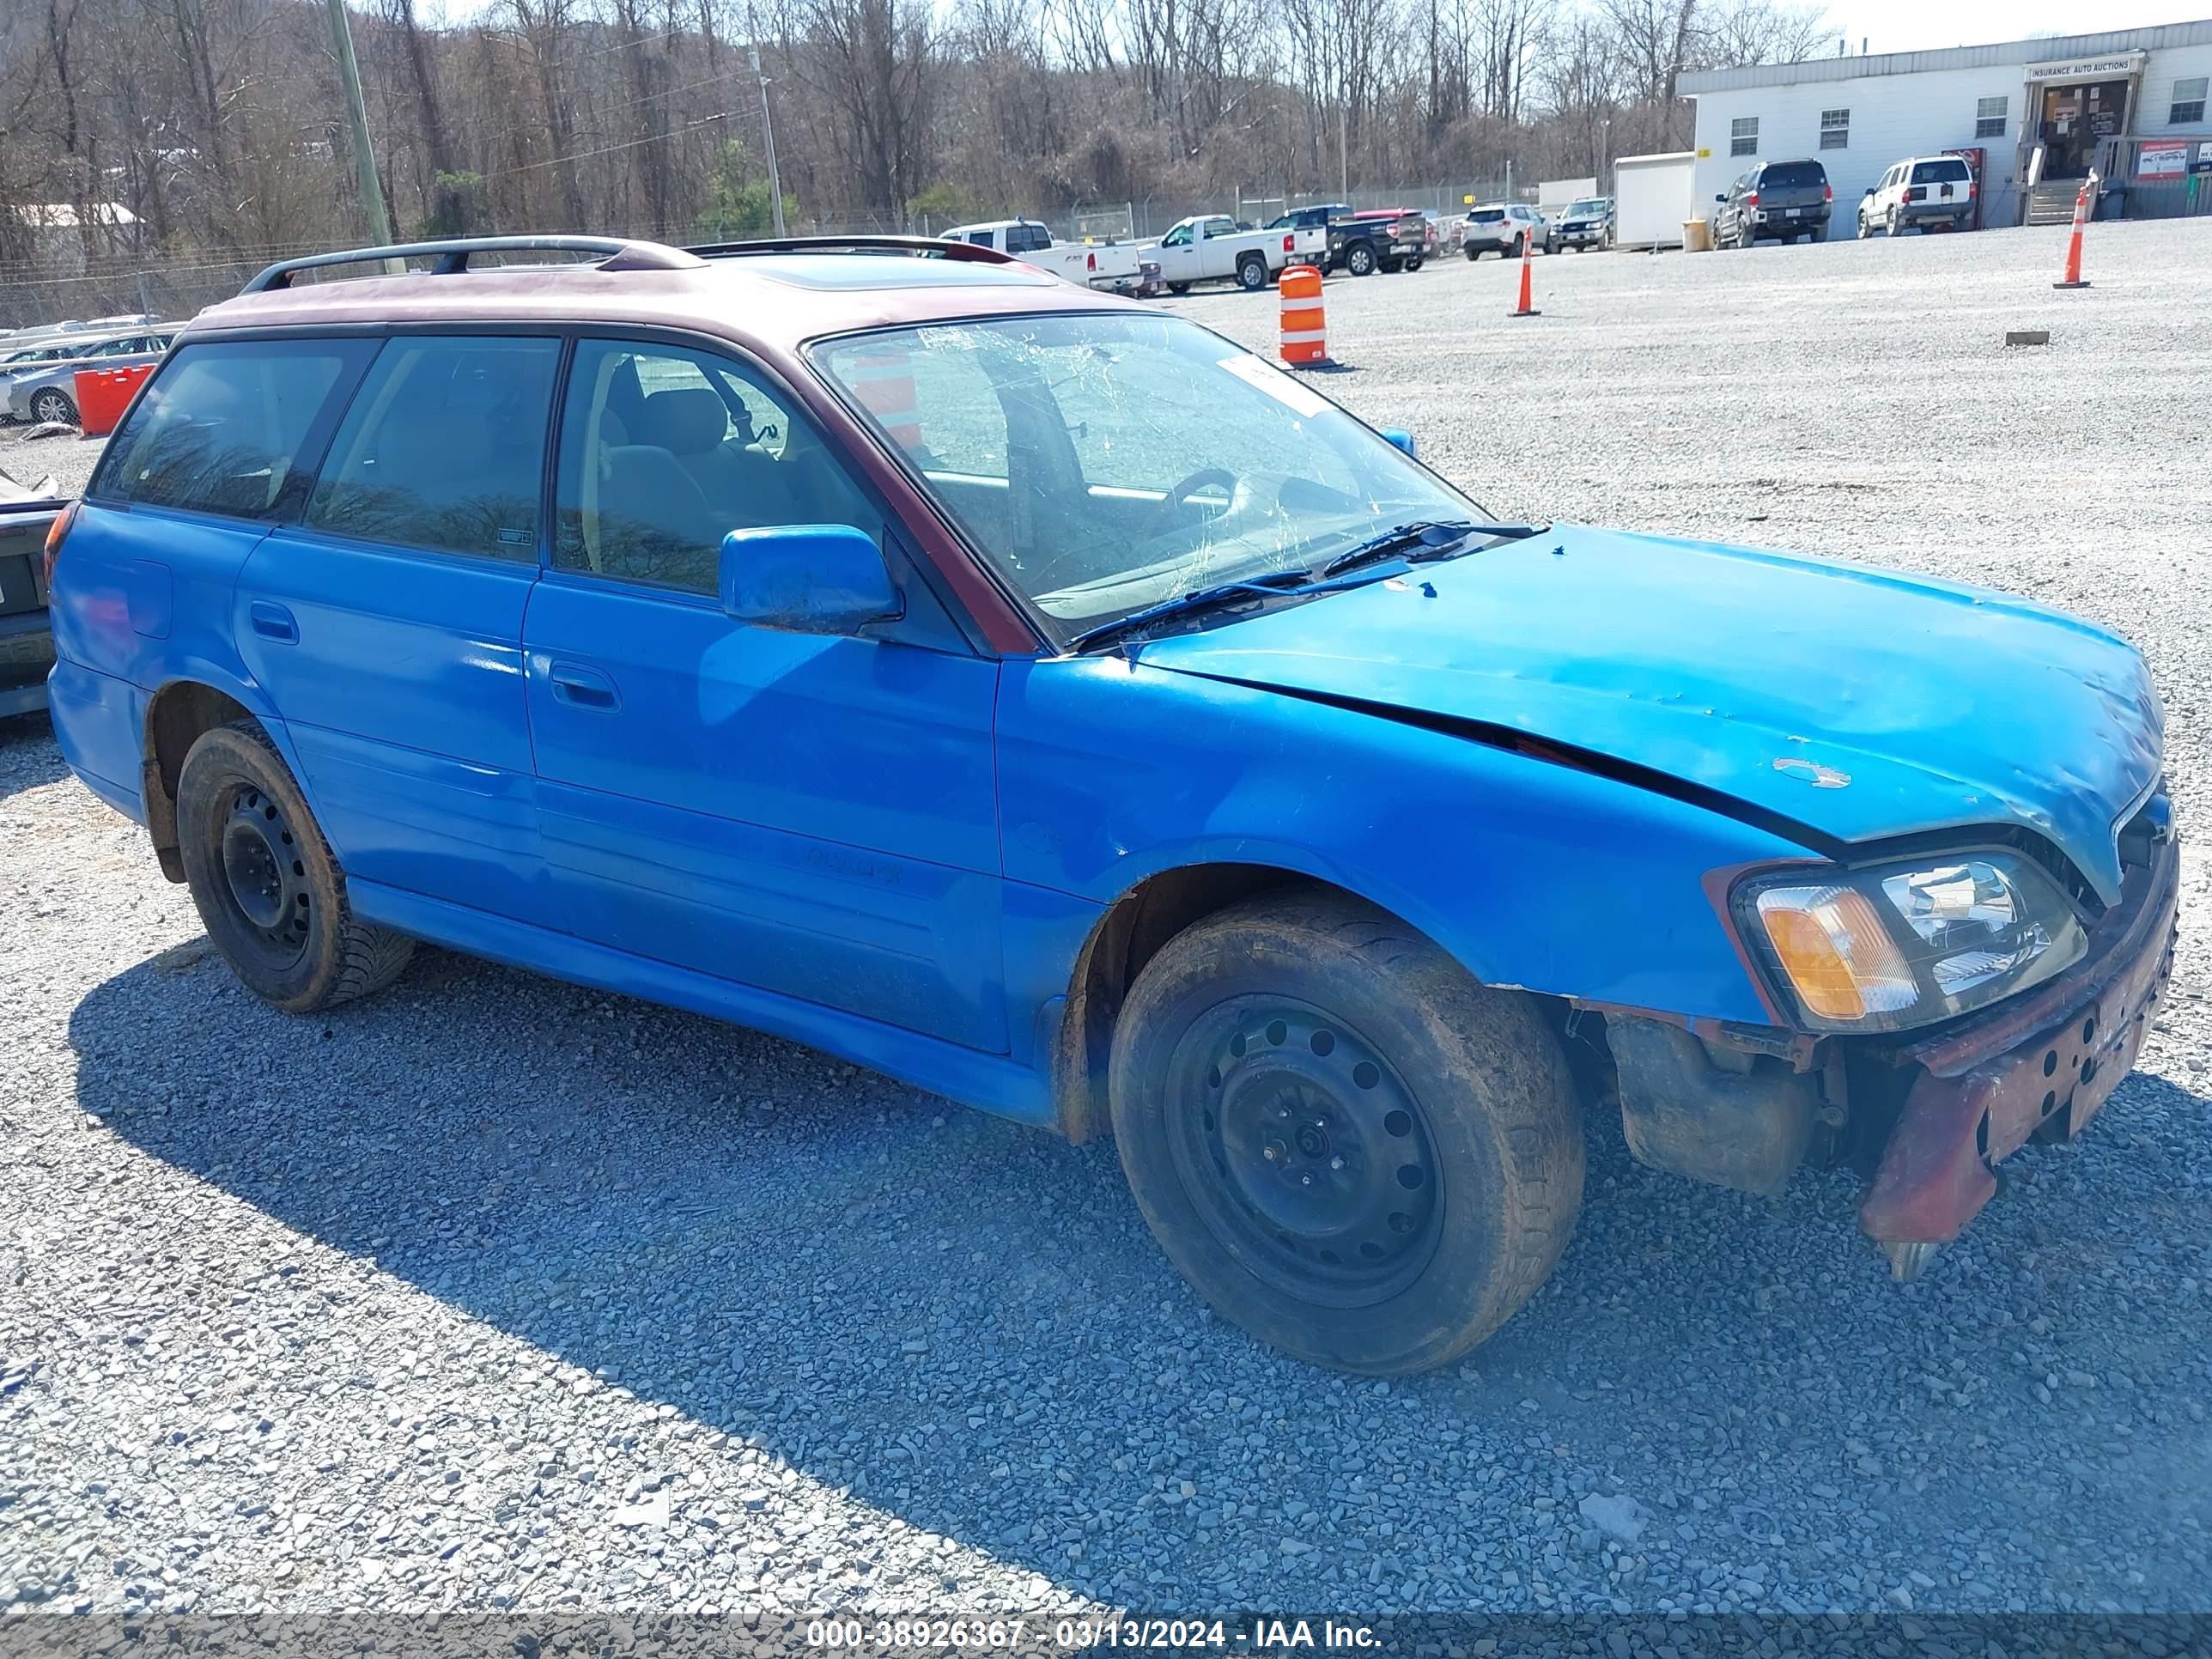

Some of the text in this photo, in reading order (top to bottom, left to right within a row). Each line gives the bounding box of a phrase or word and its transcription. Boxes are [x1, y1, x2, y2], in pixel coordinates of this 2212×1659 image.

[2032, 60, 2130, 78] INSURANCE AUTO AUCTIONS
